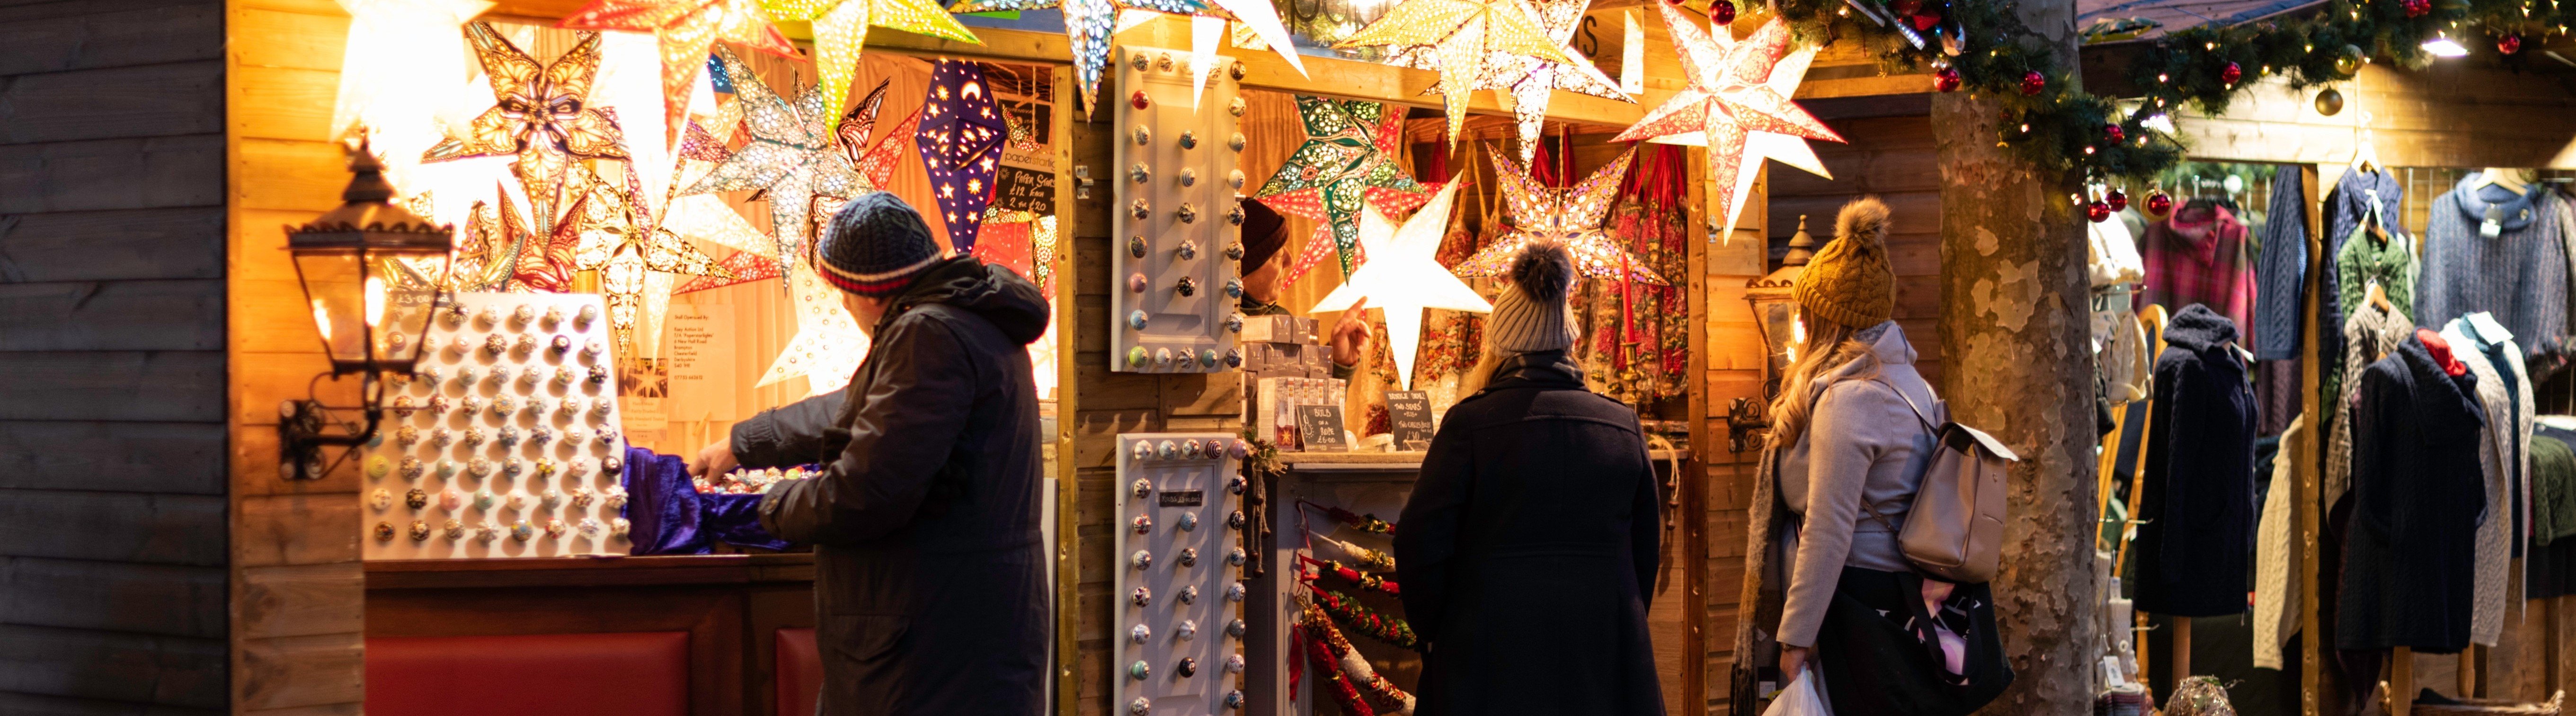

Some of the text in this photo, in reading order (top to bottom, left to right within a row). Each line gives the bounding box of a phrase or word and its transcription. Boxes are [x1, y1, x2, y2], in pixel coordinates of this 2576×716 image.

[1009, 183, 1025, 197] £12
[1010, 197, 1016, 207] 2
[1029, 198, 1046, 211] £20
[1405, 402, 1421, 411] STARS
[1314, 408, 1332, 417] BULB
[1320, 427, 1334, 436] ROPE
